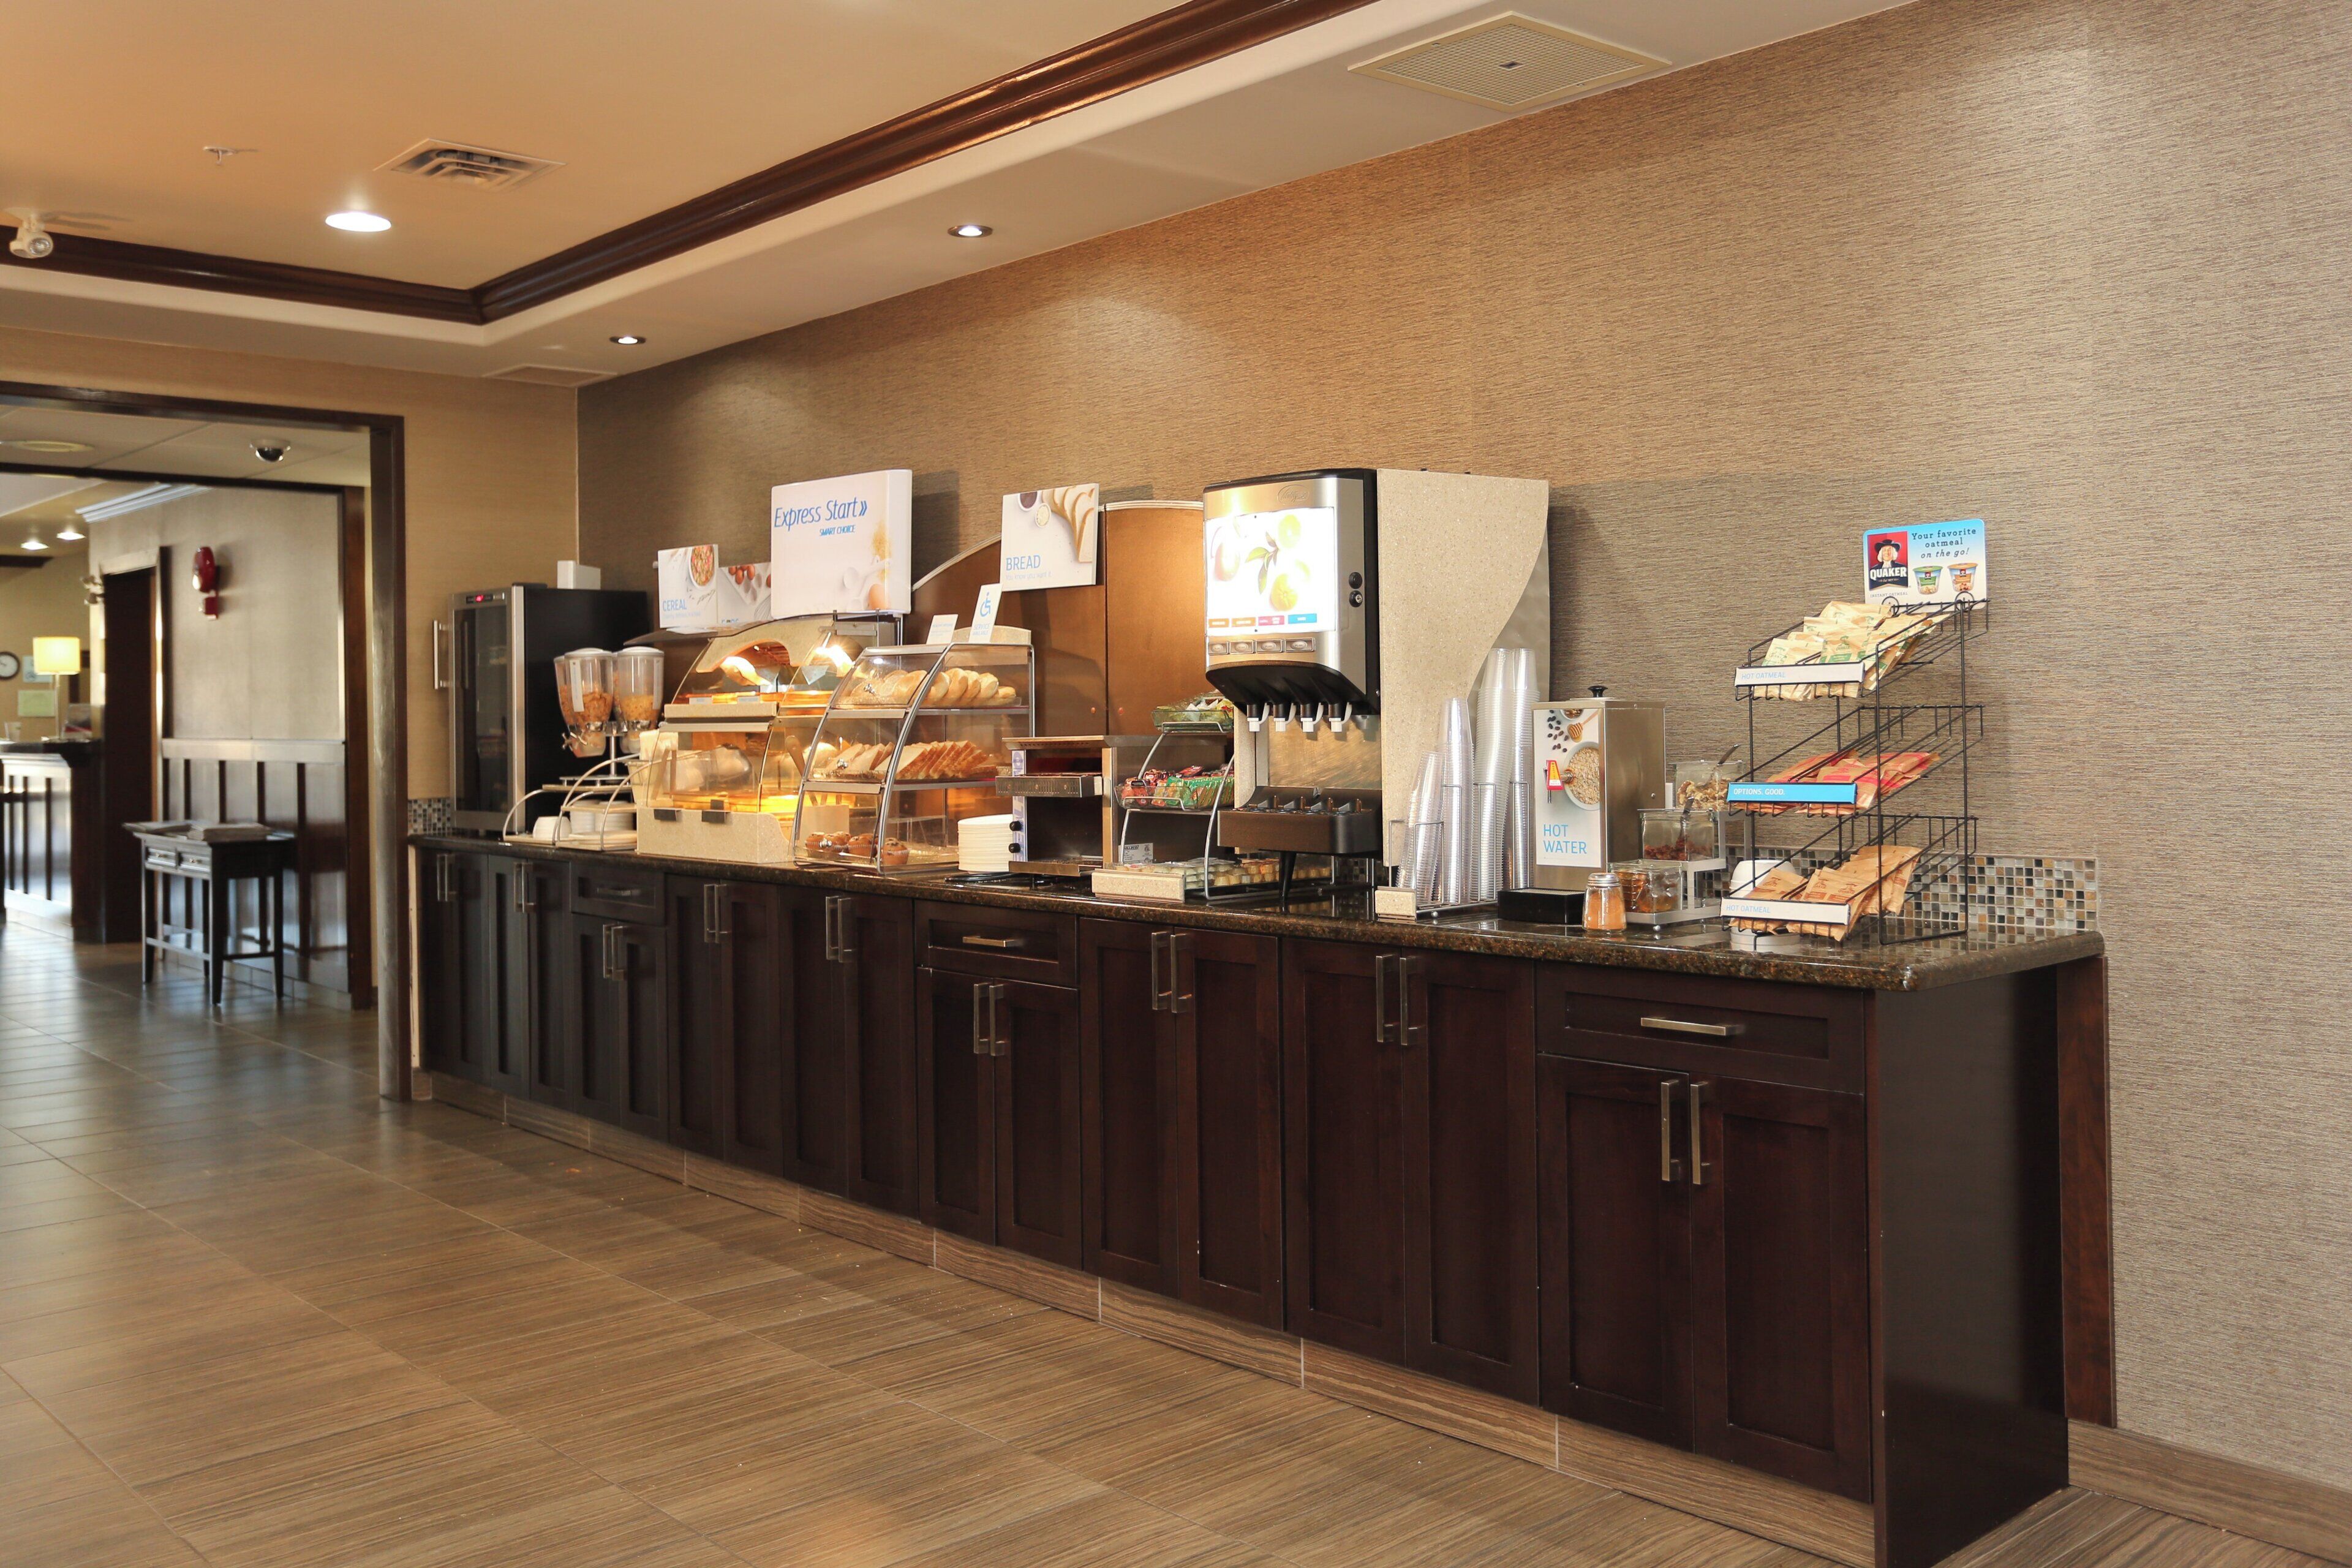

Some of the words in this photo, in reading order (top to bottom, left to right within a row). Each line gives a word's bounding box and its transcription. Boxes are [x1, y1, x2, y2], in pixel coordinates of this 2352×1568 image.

[774, 506, 821, 532] Express
[820, 526, 835, 537] SMART
[836, 524, 856, 535] CHOICE
[1912, 532, 1934, 540] Your
[1937, 528, 1977, 538] favorite
[1925, 537, 1964, 548] oatmeal
[1936, 548, 1951, 558] the
[1954, 547, 1970, 558] go!
[1006, 554, 1041, 571] BREAD
[1869, 567, 1908, 581] QUAKER
[663, 598, 687, 612] CEREAL
[1544, 824, 1568, 837] HOT
[1543, 840, 1587, 854] WATER
[1740, 905, 1771, 914] OATMEAL
